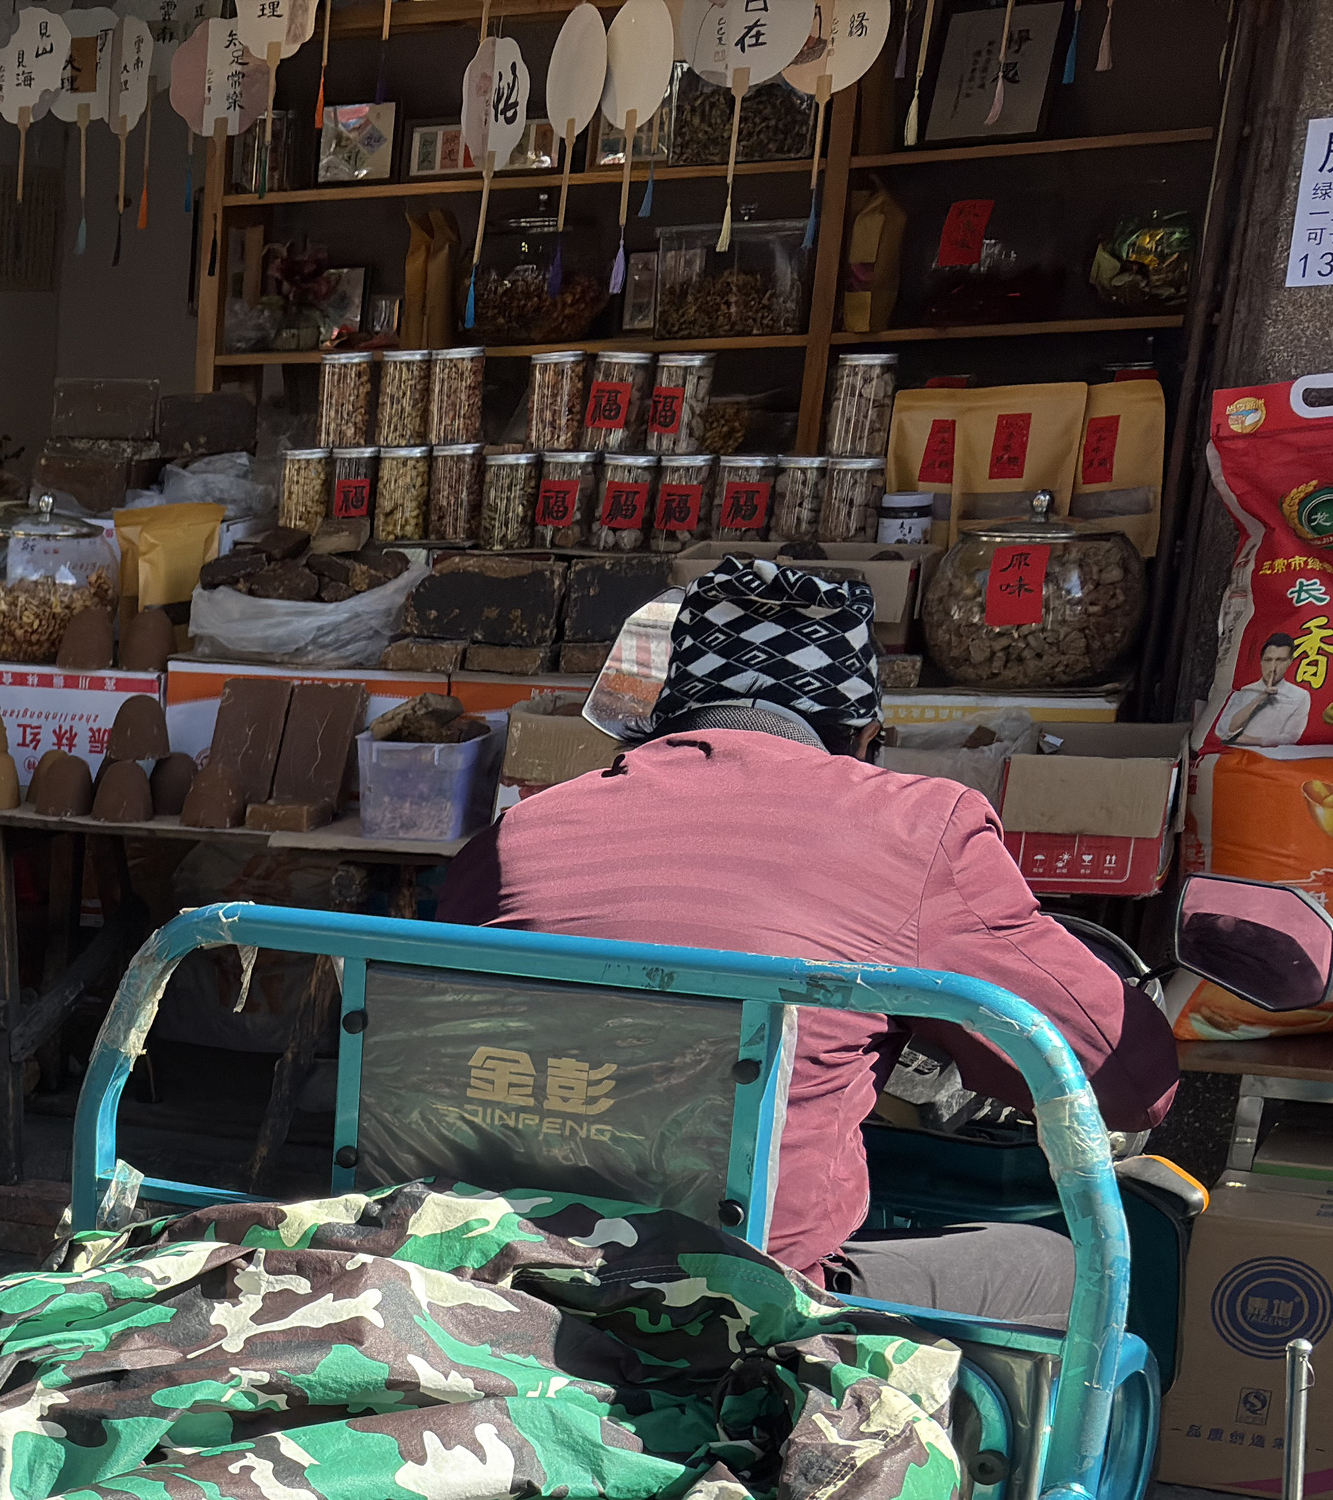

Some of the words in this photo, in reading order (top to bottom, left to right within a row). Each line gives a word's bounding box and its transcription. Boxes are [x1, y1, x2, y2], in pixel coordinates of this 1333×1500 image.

[735, 0, 769, 53] 在
[1306, 227, 1333, 246] 可
[591, 389, 622, 426] 福
[650, 394, 679, 428] 福
[339, 485, 366, 513] 福
[541, 489, 569, 521] 福
[605, 489, 637, 521] 福
[663, 493, 692, 524] 福
[729, 489, 760, 521] 福
[1287, 578, 1331, 606] 长
[466, 1045, 618, 1116] 金彭
